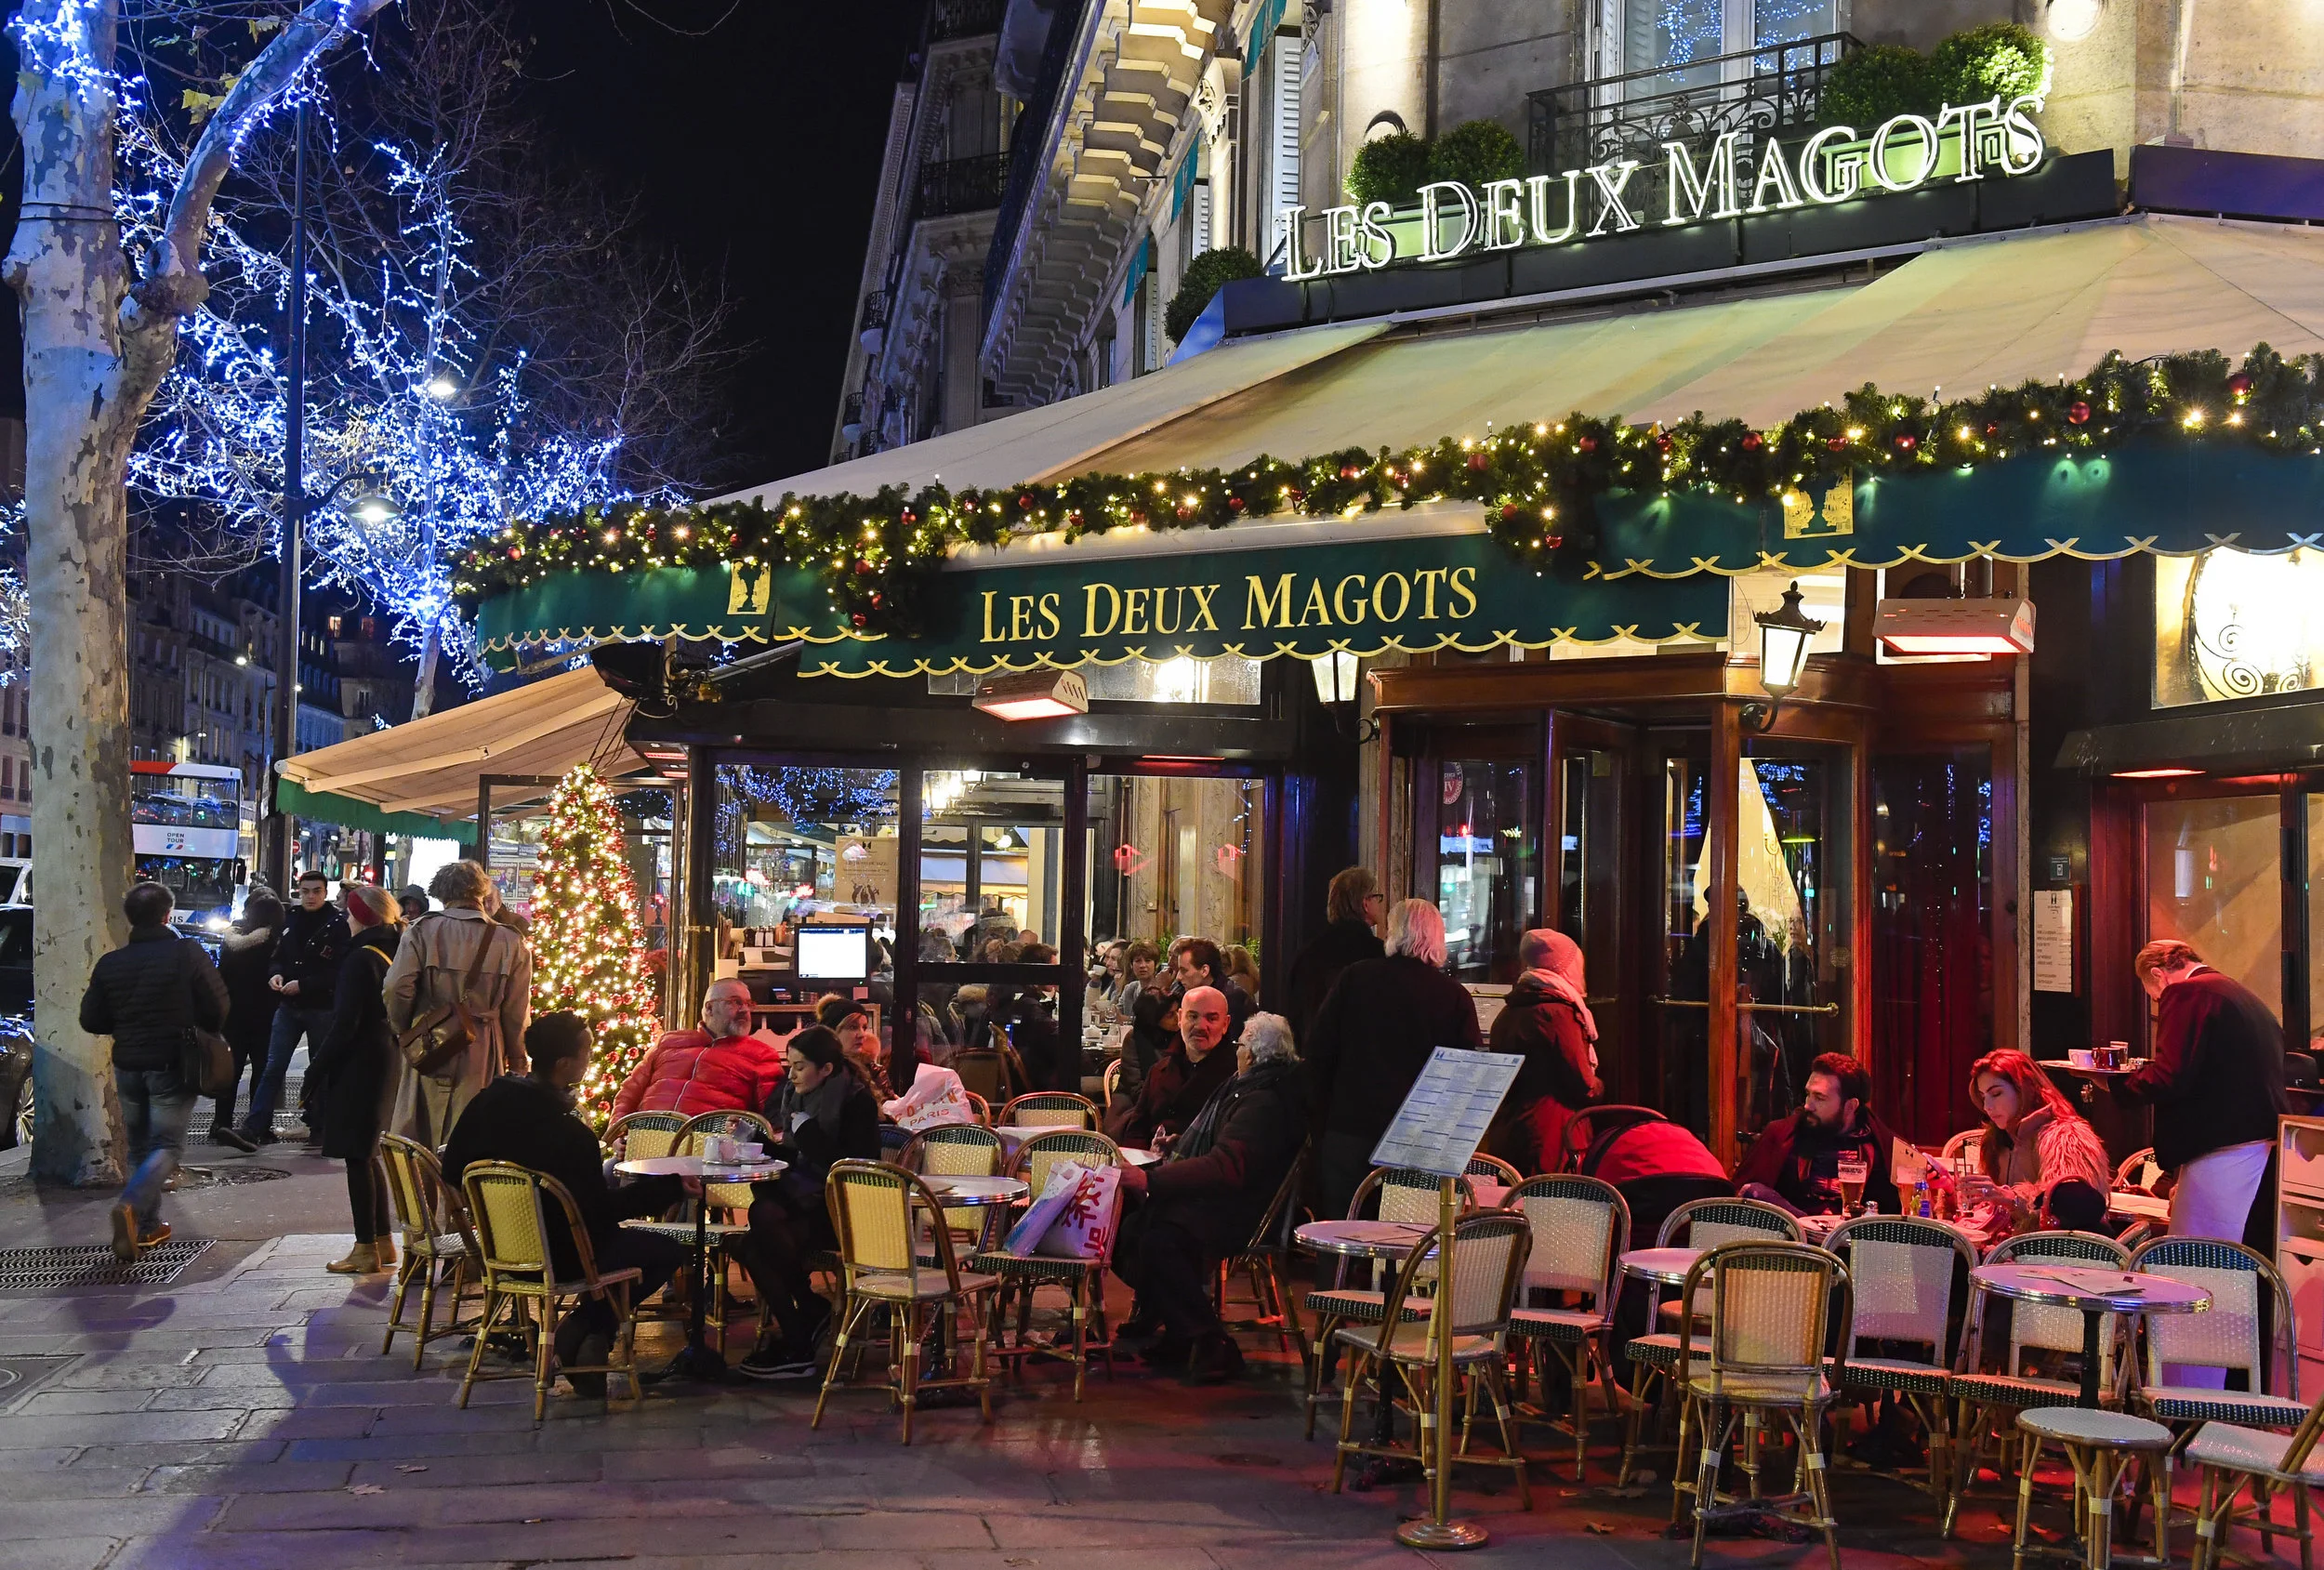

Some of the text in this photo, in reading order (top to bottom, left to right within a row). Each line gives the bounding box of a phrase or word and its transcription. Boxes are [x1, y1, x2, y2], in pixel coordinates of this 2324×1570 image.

[1281, 93, 2047, 283] LES DEUX MAGOTS
[979, 566, 1477, 643] LES DEUX MAGOTS
[910, 1108, 950, 1127] PARIS
